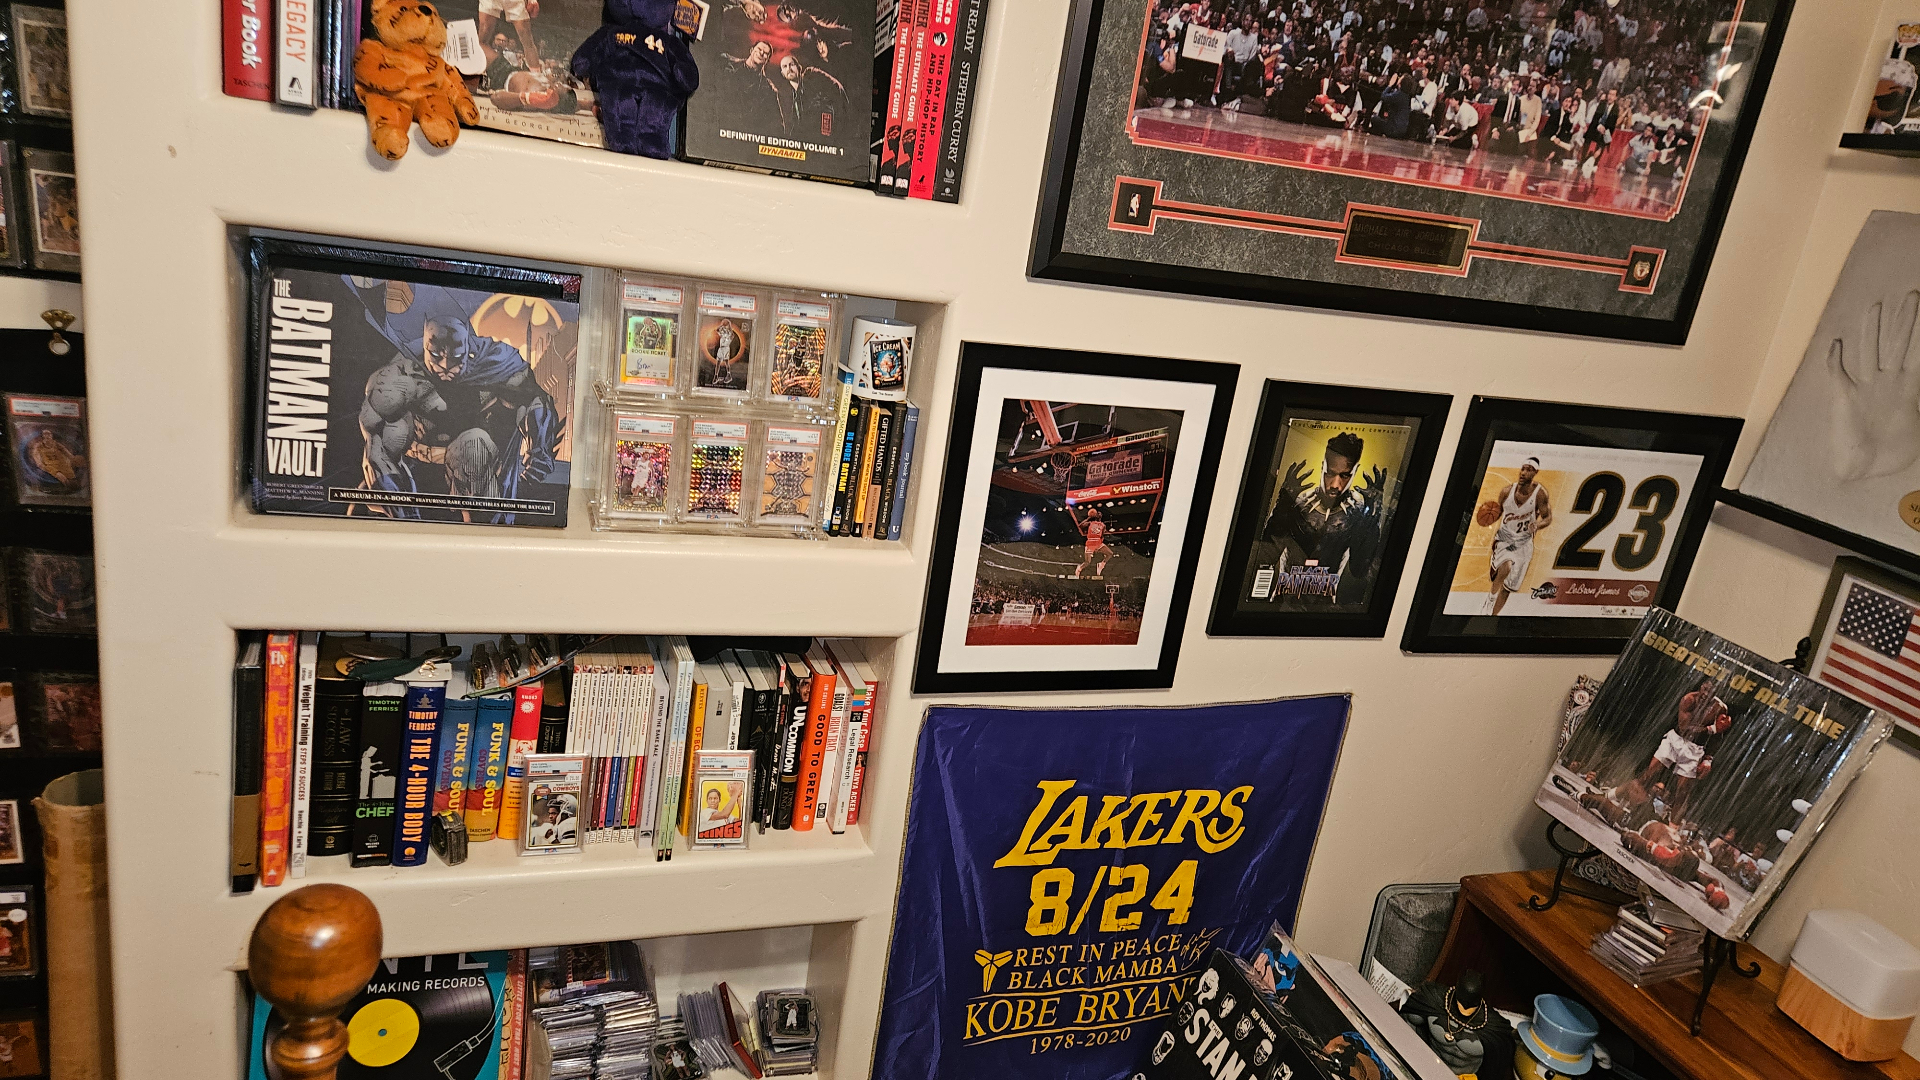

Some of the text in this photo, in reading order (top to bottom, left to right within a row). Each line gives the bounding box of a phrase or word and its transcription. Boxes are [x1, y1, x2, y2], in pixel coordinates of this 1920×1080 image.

[286, 0, 307, 63] EGACY
[944, 17, 951, 25] D
[241, 14, 262, 69] Book
[644, 34, 665, 55] 44
[1193, 31, 1219, 48] Gatorade
[233, 78, 270, 90] TASCHEN
[892, 27, 909, 119] THE ULTIMATE GUIDE
[911, 51, 922, 94] ULTIMATE
[948, 9, 979, 163] READY STEPHEN CURRY
[907, 95, 916, 122] GUIDE
[917, 53, 936, 163] AND HIP-HOP HISTORY
[929, 54, 946, 136] THIS DAY IN RAP
[506, 118, 550, 131] GEORGE
[720, 129, 844, 156] DEFINITIVE EDITION VOLUME 1
[760, 146, 804, 159] DYNAMITE
[1368, 242, 1444, 257] CHICAGO BULLS
[274, 278, 291, 298] THE
[872, 342, 901, 353] ICE CREAM
[267, 296, 333, 443] BATMAN
[840, 397, 848, 419] GREEN
[835, 419, 844, 452] SMOOTHIE
[874, 417, 888, 472] GIFTED HANDS
[1125, 430, 1159, 442] Gatorade
[267, 439, 327, 477] VAULT
[838, 432, 854, 493] BE MORE BATMAN
[1089, 457, 1140, 475] Gatorade
[843, 443, 861, 520] ESSENTIAL BLACK WISDOM
[880, 446, 897, 523] ESSENTIAL BLACK WISDOM
[897, 451, 910, 498] my book journal
[1122, 483, 1160, 493] Winston
[462, 500, 500, 508] COLLECTIBLES
[1516, 521, 1530, 533] 23
[1552, 470, 1681, 571] 23
[1290, 566, 1331, 575] BLACK
[1275, 573, 1340, 599] PANTHER
[1566, 583, 1621, 598] LeBron James
[300, 685, 312, 711] Weight
[1642, 631, 1731, 682] GREATEST
[1730, 675, 1757, 694] OF
[1754, 687, 1790, 715] ALL
[1794, 704, 1845, 740] TIME
[299, 714, 311, 745] Training
[409, 711, 438, 720] TIMOTHY
[409, 722, 436, 731] FERRISS
[813, 713, 826, 746] GOOD
[825, 692, 845, 753] GOALS! BRIAN TRACY
[857, 683, 875, 749] Make Your Case
[695, 726, 702, 738] OF
[784, 706, 807, 773] UNCOMMON
[847, 727, 857, 747] Legal
[410, 738, 432, 760] THE
[452, 723, 470, 778] FUNK &
[810, 751, 820, 767] TO
[300, 766, 306, 774] TO
[440, 750, 452, 792] COVERS
[475, 749, 487, 790] COVERS
[482, 723, 504, 816] FUNK & SOUL
[844, 748, 854, 780] Research
[298, 776, 306, 801] SUCCESS
[803, 771, 817, 810] GREAT
[848, 768, 861, 812] TANYA ACKER
[356, 807, 395, 818] CHEF
[402, 812, 424, 842] BODY
[993, 779, 1254, 869] LAKERS
[1025, 860, 1199, 936] 8/24
[1013, 944, 1072, 968] REST
[1080, 942, 1104, 964] IN
[1111, 934, 1182, 961] PEACE
[367, 976, 485, 995] MAKING RECORDS
[1008, 960, 1178, 990] BLACK MAMBA
[962, 976, 1196, 1041] KOBE BRYAN
[513, 1027, 521, 1045] THAT
[1210, 1021, 1220, 1037] THE
[1250, 1008, 1277, 1042] ROY THOMAS
[512, 1046, 520, 1065] MUST
[1030, 1027, 1130, 1055] 1978-2020
[512, 1067, 518, 1075] BE
